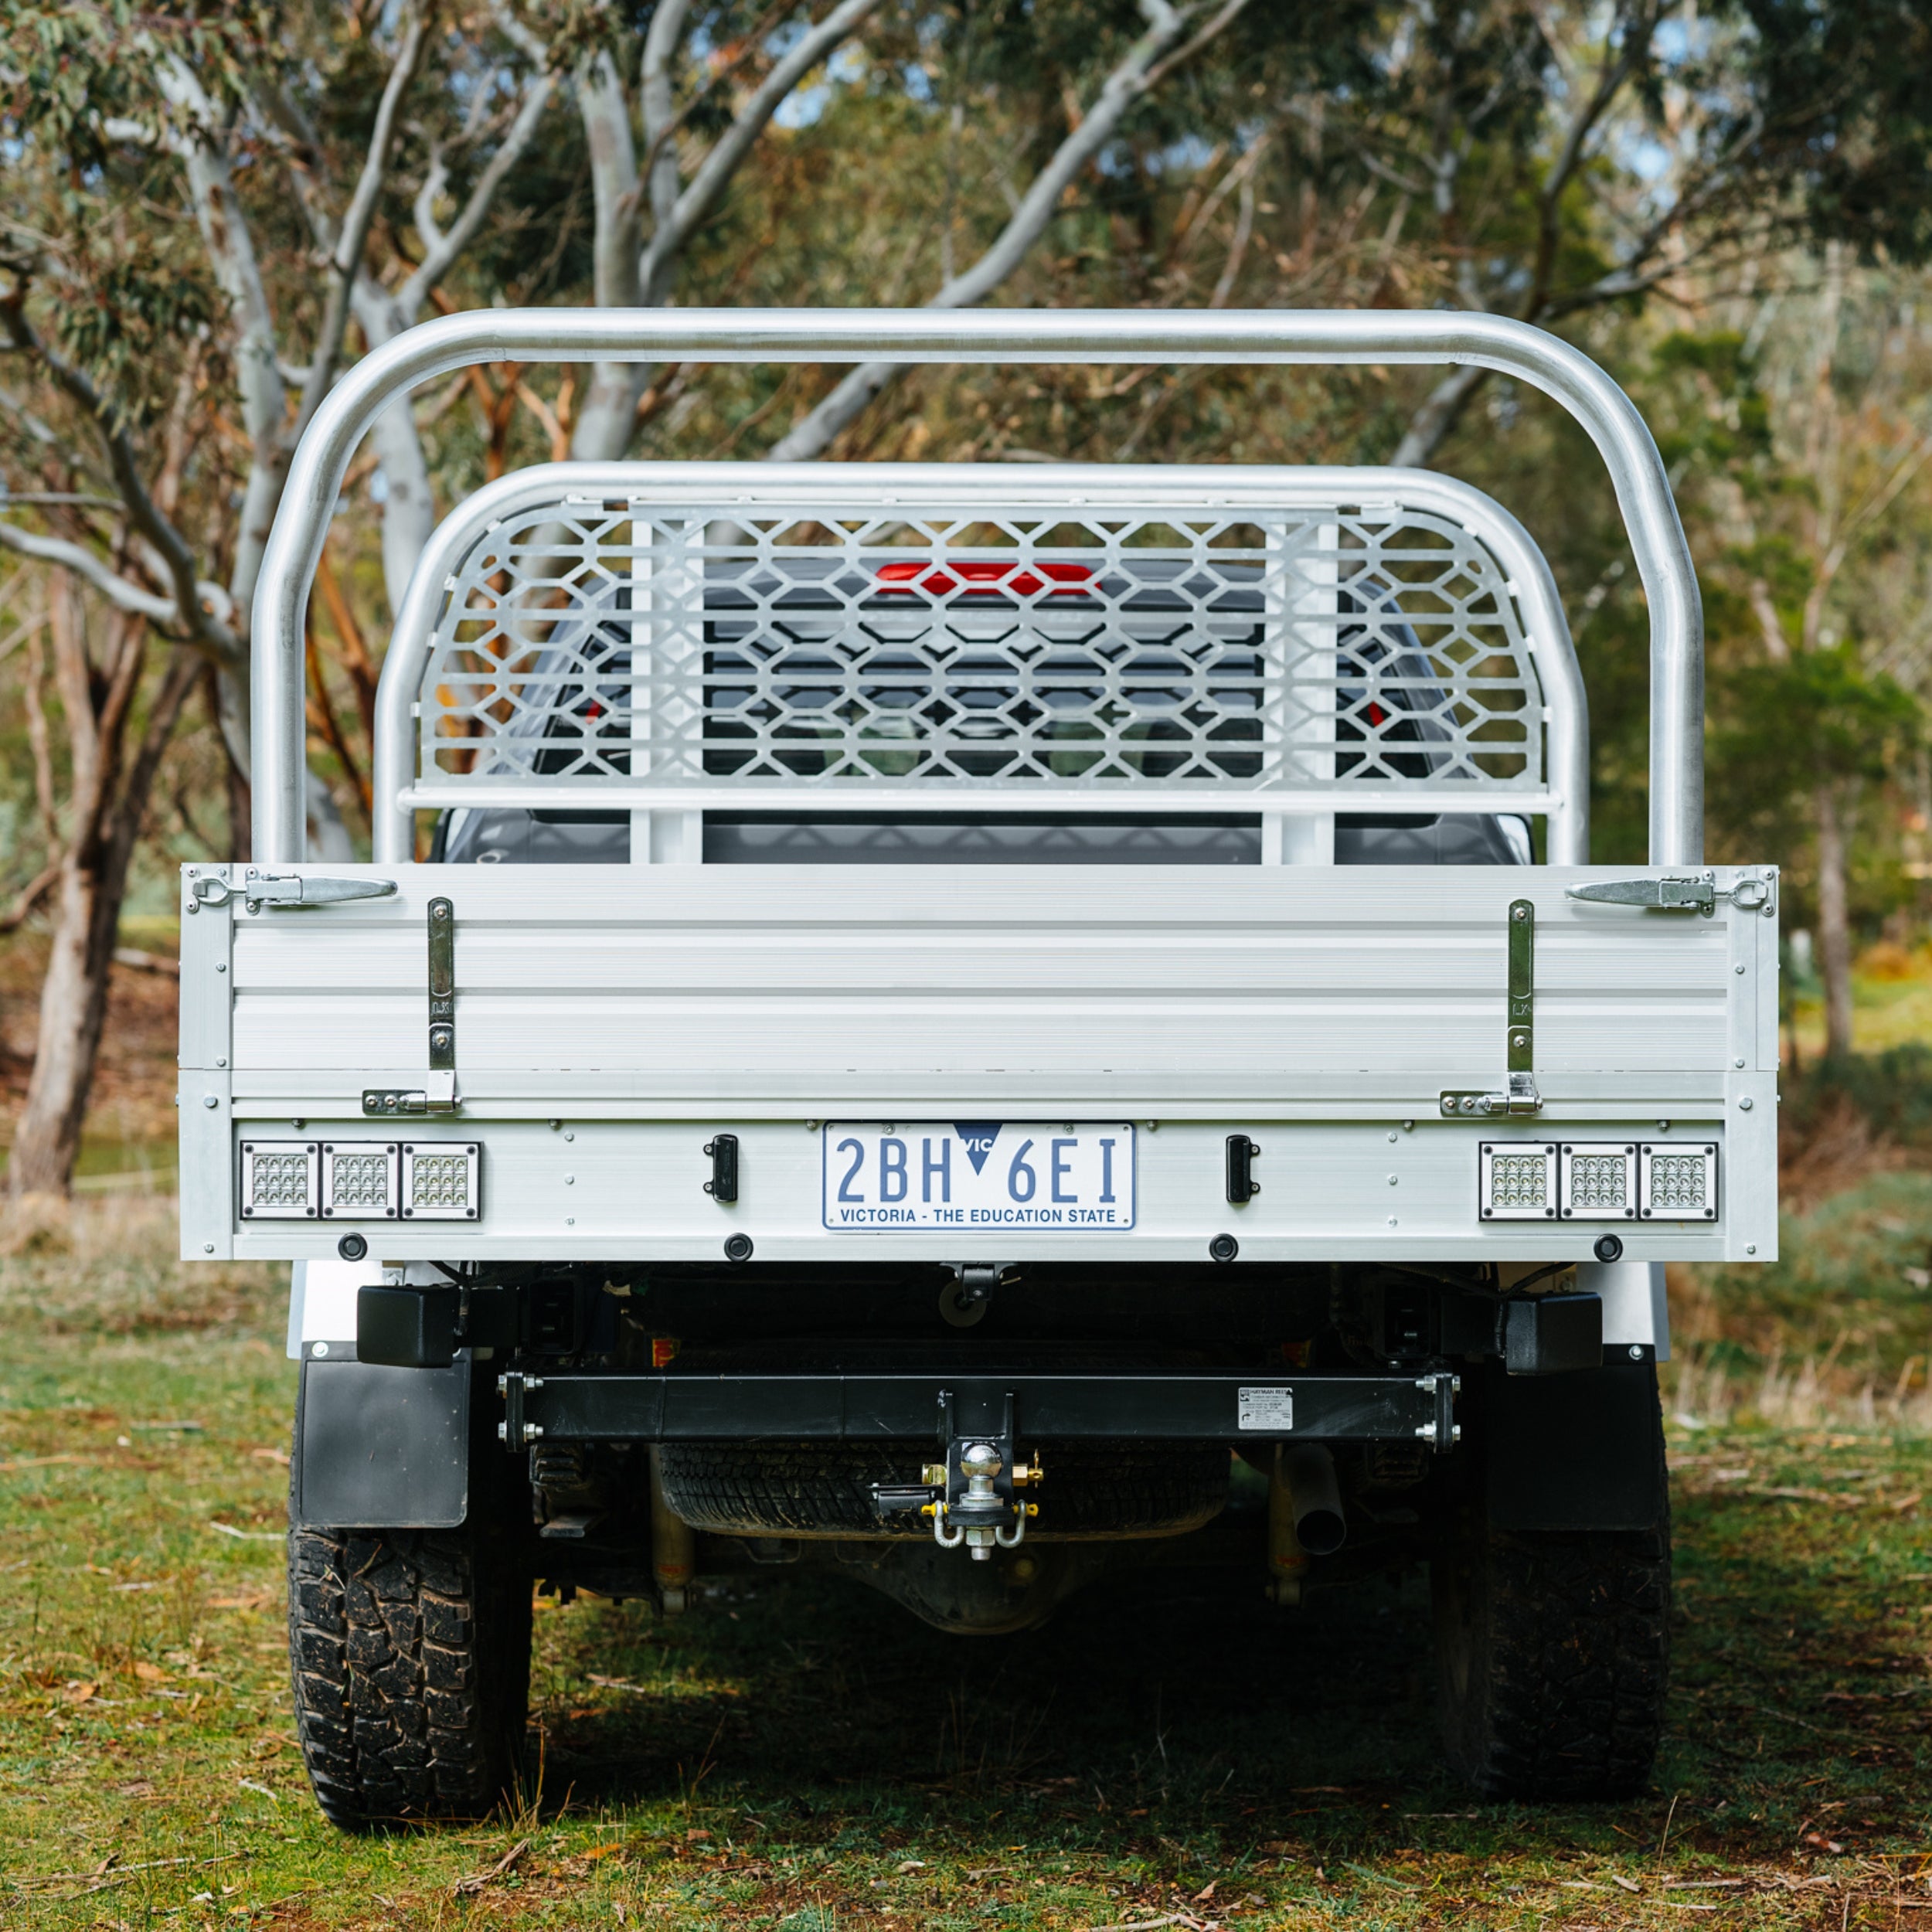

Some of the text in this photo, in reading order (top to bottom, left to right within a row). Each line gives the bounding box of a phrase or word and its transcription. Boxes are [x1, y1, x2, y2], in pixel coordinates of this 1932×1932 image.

[959, 1138, 993, 1152] VIC
[837, 1138, 1116, 1203] 2BH 6EI
[841, 1209, 917, 1223] VICTORIA
[934, 1209, 964, 1222] THE
[970, 1209, 1062, 1223] EDUCATION
[1068, 1209, 1116, 1223] STATE
